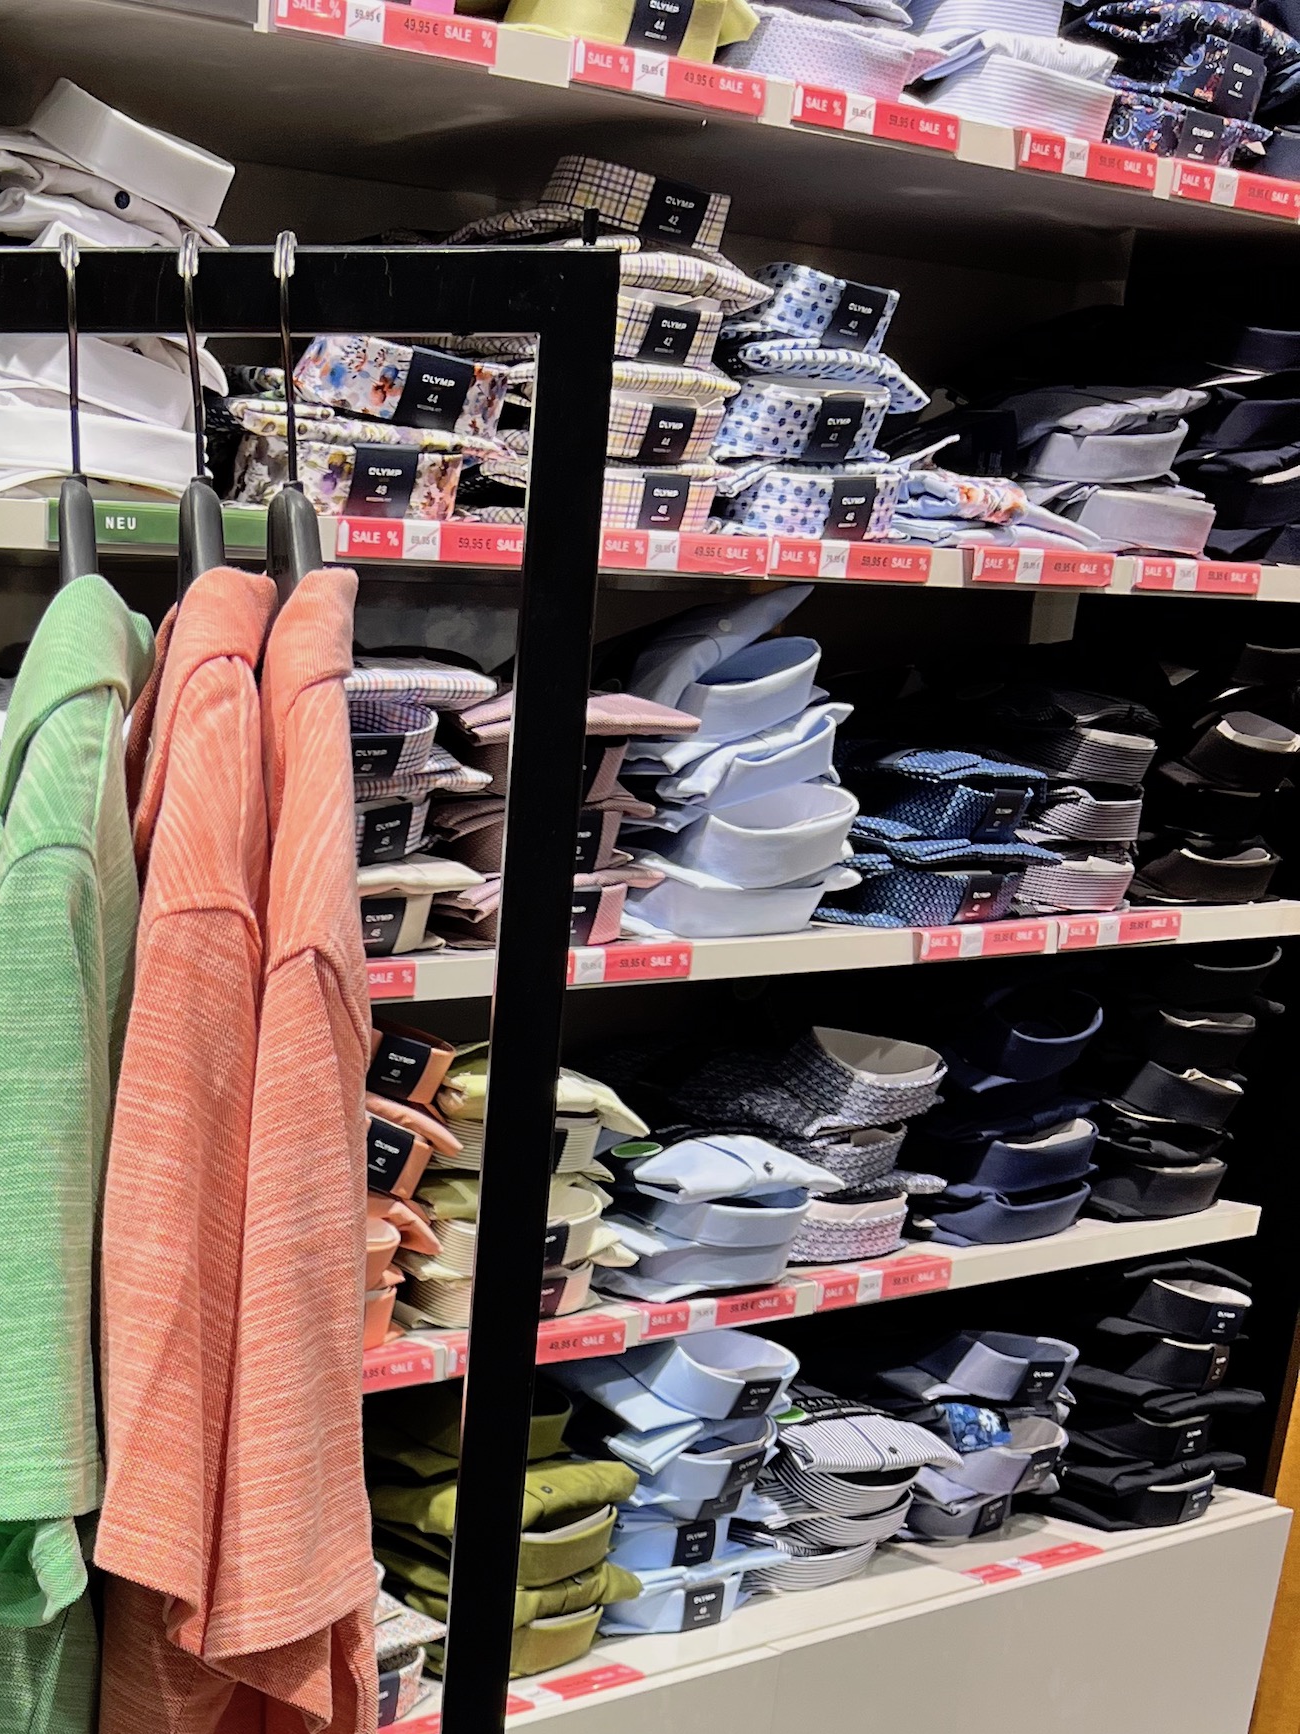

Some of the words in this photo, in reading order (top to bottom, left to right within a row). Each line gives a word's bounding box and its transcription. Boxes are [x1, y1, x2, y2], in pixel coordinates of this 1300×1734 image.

[649, 0, 679, 14] OLYMP
[355, 9, 375, 22] 59,95
[404, 18, 430, 34] 49,95
[432, 23, 439, 36] €
[444, 26, 472, 43] SALE
[482, 31, 492, 48] %
[653, 20, 665, 31] 44
[587, 52, 612, 68] SALE
[619, 57, 629, 73] %
[684, 72, 706, 86] 49,95
[708, 77, 714, 88] €
[719, 78, 743, 94] SALE
[752, 84, 761, 99] %
[805, 97, 828, 113] SALE
[832, 101, 842, 116] %
[919, 121, 940, 135] SALE
[947, 125, 956, 140] %
[1031, 142, 1050, 156] SALE
[1054, 145, 1061, 159] %
[1124, 159, 1142, 174] SALE
[1182, 174, 1199, 186] SALE
[1271, 191, 1289, 203] SALE
[665, 195, 695, 209] OLYMP
[668, 214, 680, 227] 42
[848, 302, 873, 315] OLYMP
[661, 319, 687, 331] OLYMP
[422, 374, 455, 388] OLYMP
[427, 393, 439, 404] 44
[659, 419, 683, 431] OLYMP
[368, 466, 402, 477] OLYMP
[105, 516, 136, 530] NEU
[352, 530, 381, 545] SALE
[386, 530, 399, 546] %
[458, 537, 483, 550] 59,95
[485, 539, 492, 550] €
[497, 539, 523, 552] SALE
[605, 539, 629, 552] SALE
[634, 540, 645, 555] %
[694, 545, 715, 558] 49,95
[716, 547, 723, 558] €
[725, 547, 749, 560] SALE
[756, 548, 765, 562] %
[781, 551, 803, 563] SALE
[808, 551, 817, 565] %
[891, 557, 912, 569] SALE
[919, 558, 928, 571] %
[984, 558, 1004, 569] SALE
[1008, 558, 1015, 571] %
[1079, 563, 1098, 574] SALE
[1145, 566, 1162, 577] SALE
[1231, 572, 1248, 583] SALE
[355, 749, 388, 758] OLYMP
[650, 955, 672, 968] SALE
[679, 953, 688, 967] %
[369, 971, 394, 985] SALE
[402, 969, 413, 984] %
[825, 1286, 844, 1298] SALE
[918, 1271, 936, 1282] SALE
[651, 1313, 673, 1326] SALE
[677, 1311, 686, 1323] %
[758, 1297, 779, 1309] SALE
[581, 1335, 605, 1347] SALE
[612, 1331, 622, 1344] %
[390, 1361, 414, 1375] SALE
